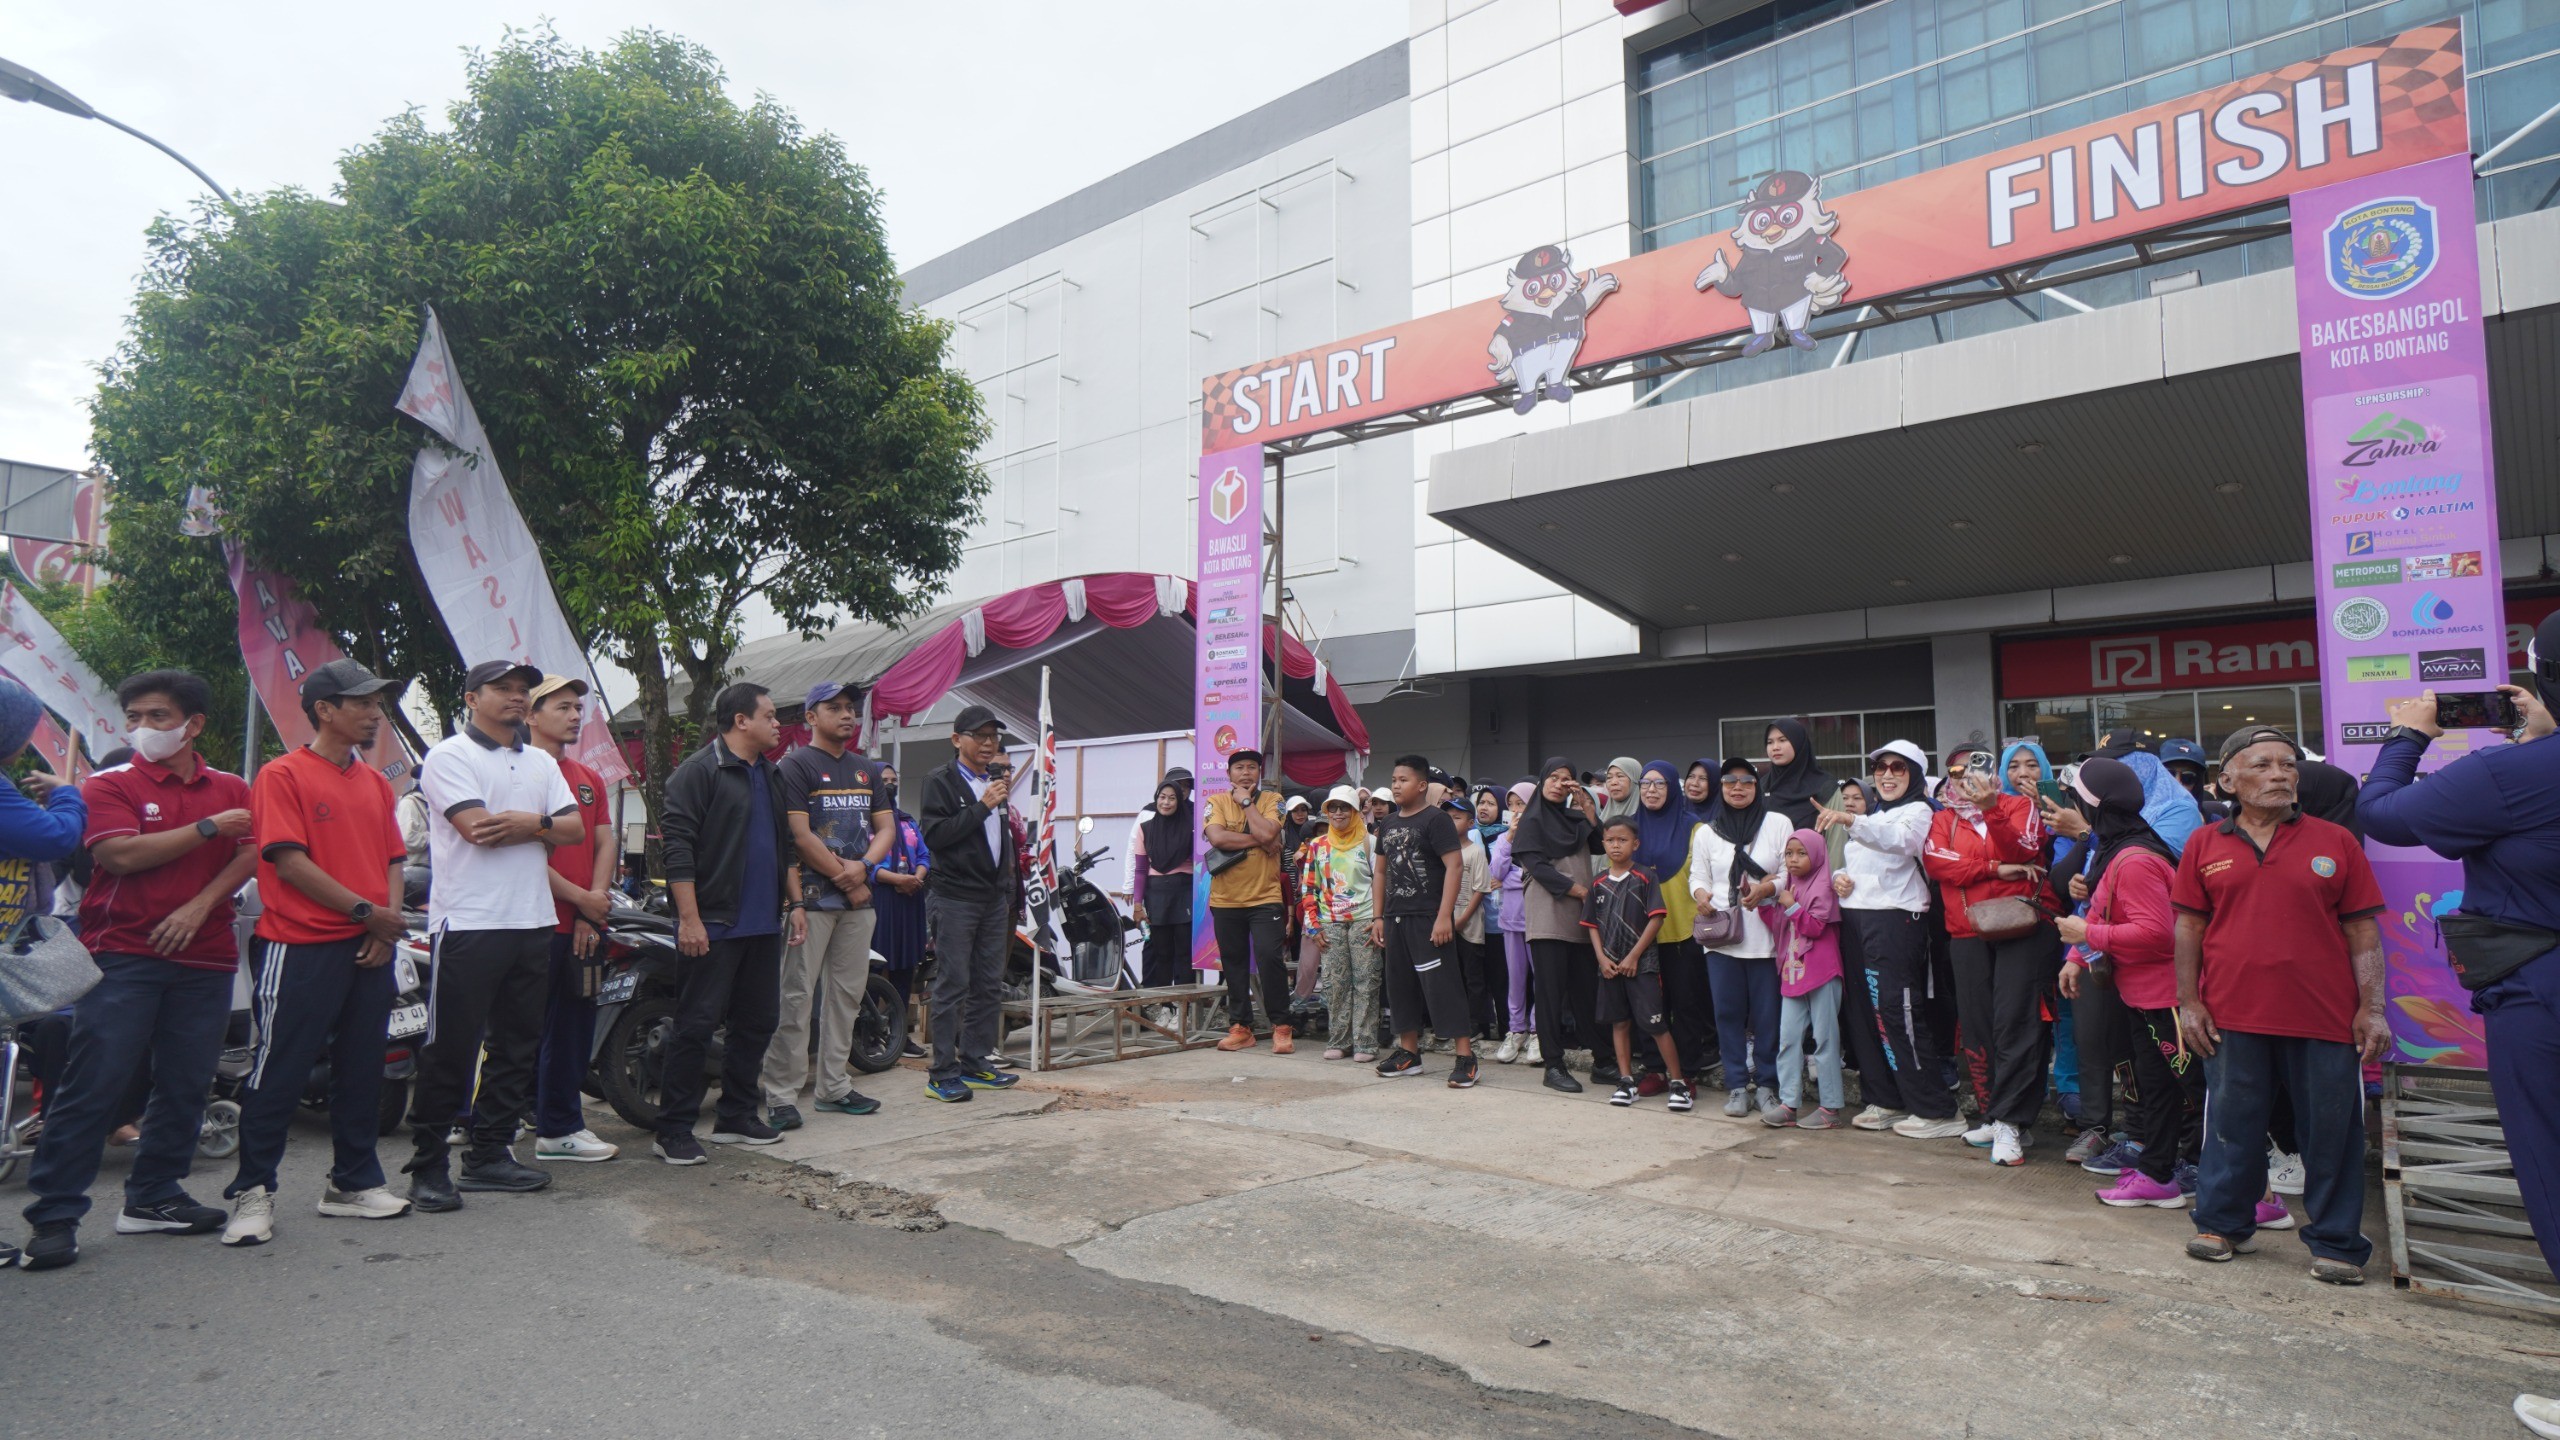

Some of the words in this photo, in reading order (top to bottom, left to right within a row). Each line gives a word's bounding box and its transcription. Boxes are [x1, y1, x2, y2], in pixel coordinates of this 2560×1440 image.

[1988, 60, 2381, 249] FINISH
[2344, 212, 2369, 227] KOTA
[2370, 205, 2413, 217] BONTANG
[2311, 297, 2469, 347] BAKESBANGPOL
[2330, 345, 2370, 369] KOTA
[2374, 331, 2449, 362] BONTANG
[1232, 336, 1397, 435] START
[2341, 439, 2442, 467] Zahwa
[2331, 510, 2388, 525] PUPUK
[2414, 501, 2475, 516] KALTIM
[1208, 533, 1247, 556] BAWASLU
[1203, 560, 1220, 574] KOTA
[1221, 554, 1252, 572] BONTANG
[2336, 564, 2398, 578] METROPOLIS
[2392, 628, 2444, 637] BONTANG
[2447, 624, 2484, 634] MIGAS
[2362, 670, 2397, 678] INNAYAH
[2423, 663, 2480, 673] AWRAA
[823, 795, 871, 808] BAWASLU
[2206, 859, 2234, 870] NETWORK
